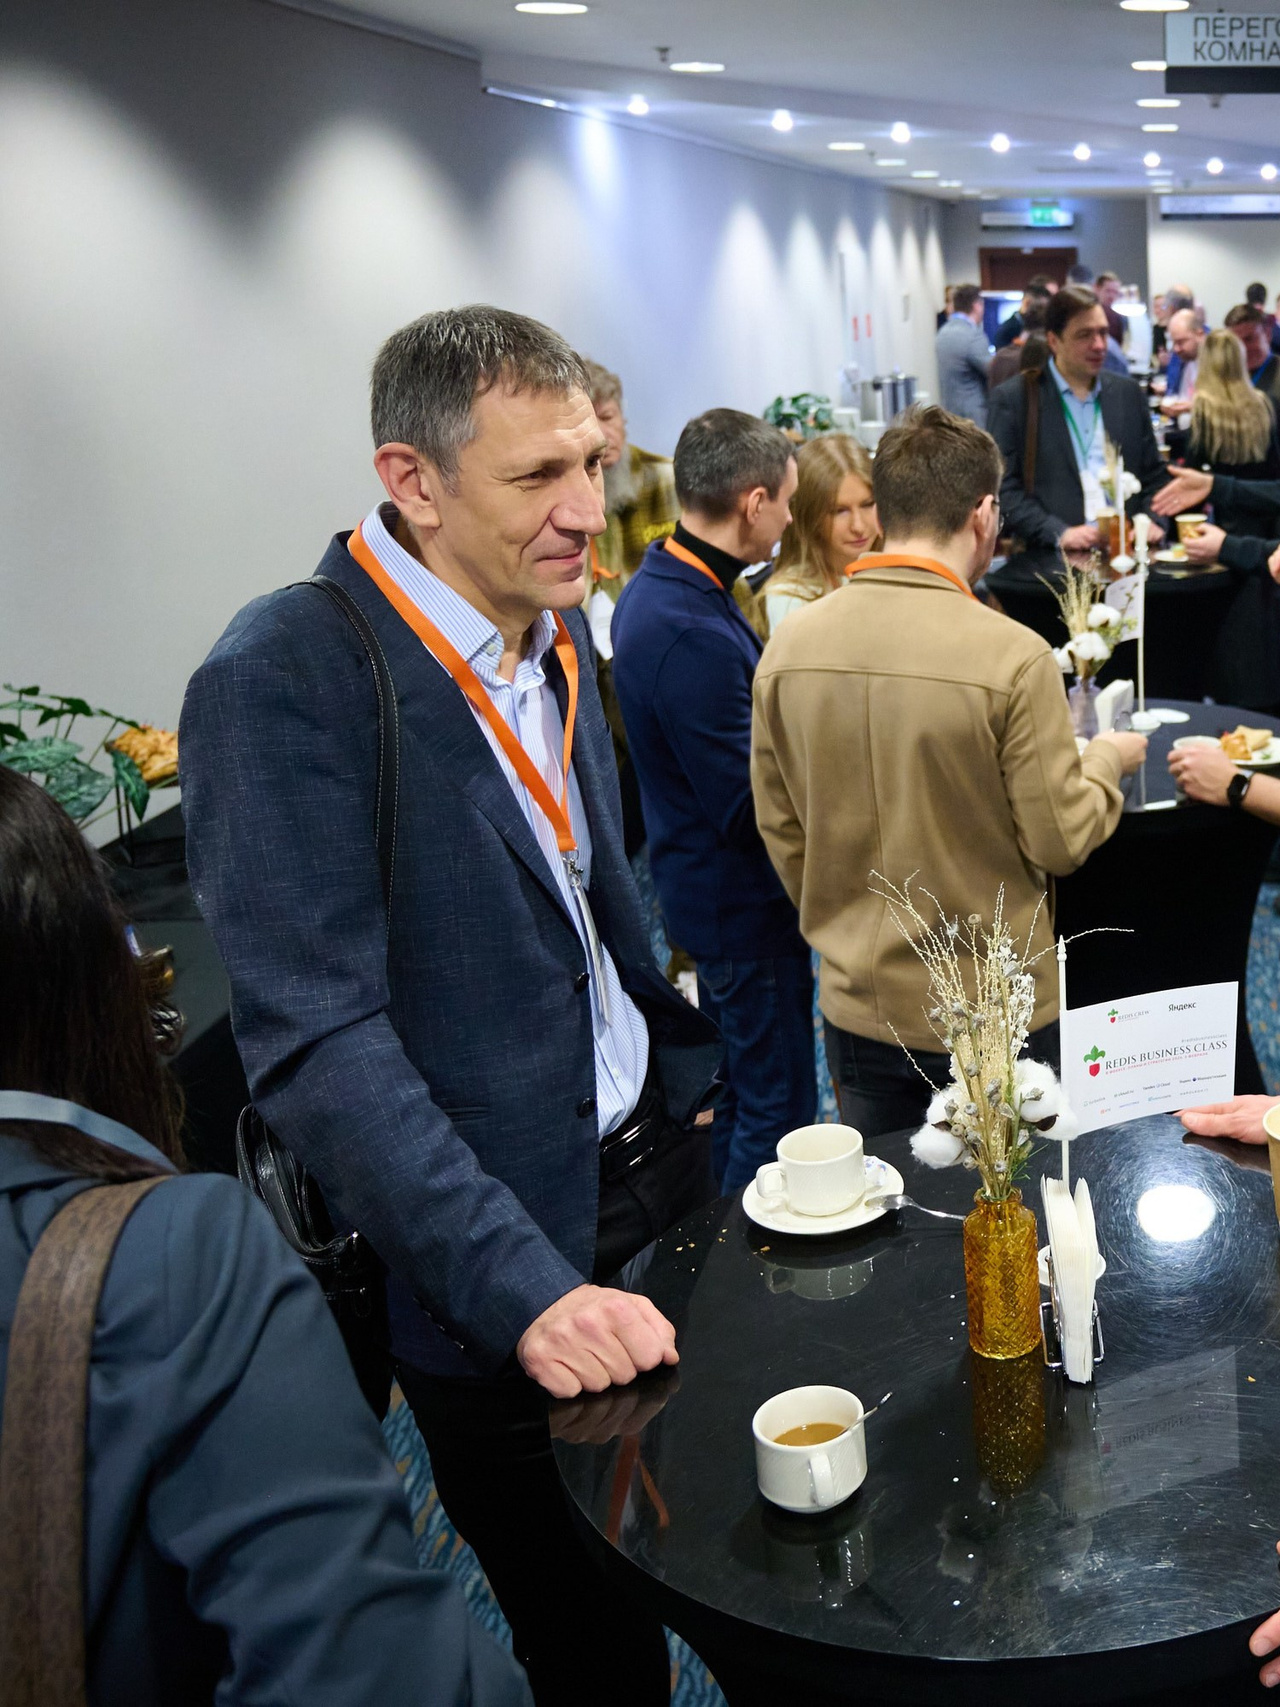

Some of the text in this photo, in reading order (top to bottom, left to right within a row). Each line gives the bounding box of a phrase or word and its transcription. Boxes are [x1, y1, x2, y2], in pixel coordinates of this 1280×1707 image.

[1168, 1002, 1197, 1012] Яндекс
[1105, 1040, 1228, 1070] REDIS BUSINESS CLASS
